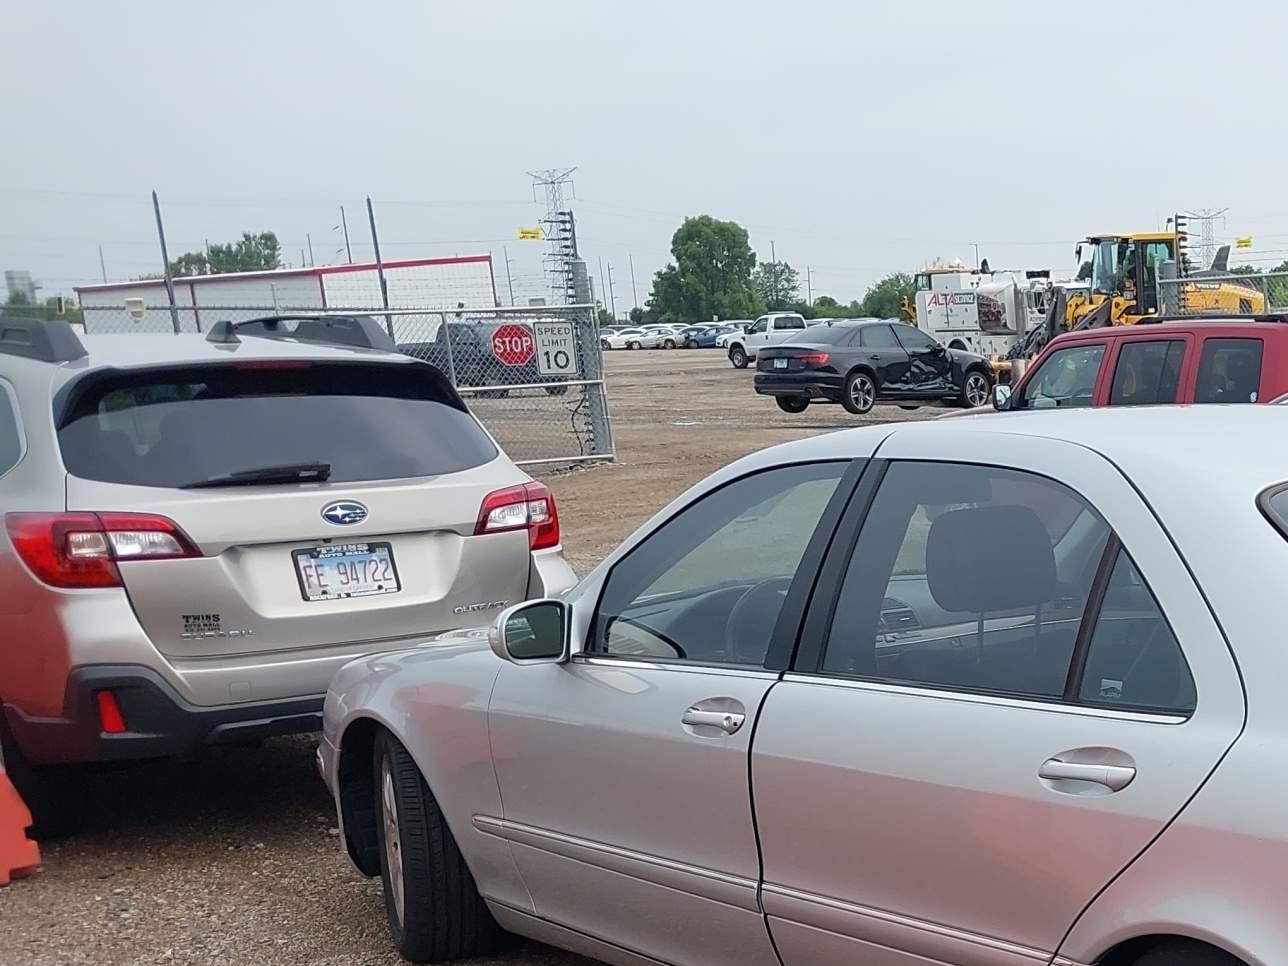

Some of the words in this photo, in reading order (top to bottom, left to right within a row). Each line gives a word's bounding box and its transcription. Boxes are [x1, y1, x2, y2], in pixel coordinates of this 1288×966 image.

[928, 292, 956, 306] ALTA
[537, 327, 571, 335] SPEED
[494, 337, 532, 353] STOP
[542, 338, 568, 347] LIMIT
[543, 350, 570, 370] 10
[313, 543, 369, 554] TWINS
[303, 564, 329, 589] FE
[337, 558, 393, 585] 94722
[182, 614, 221, 623] TWINS
